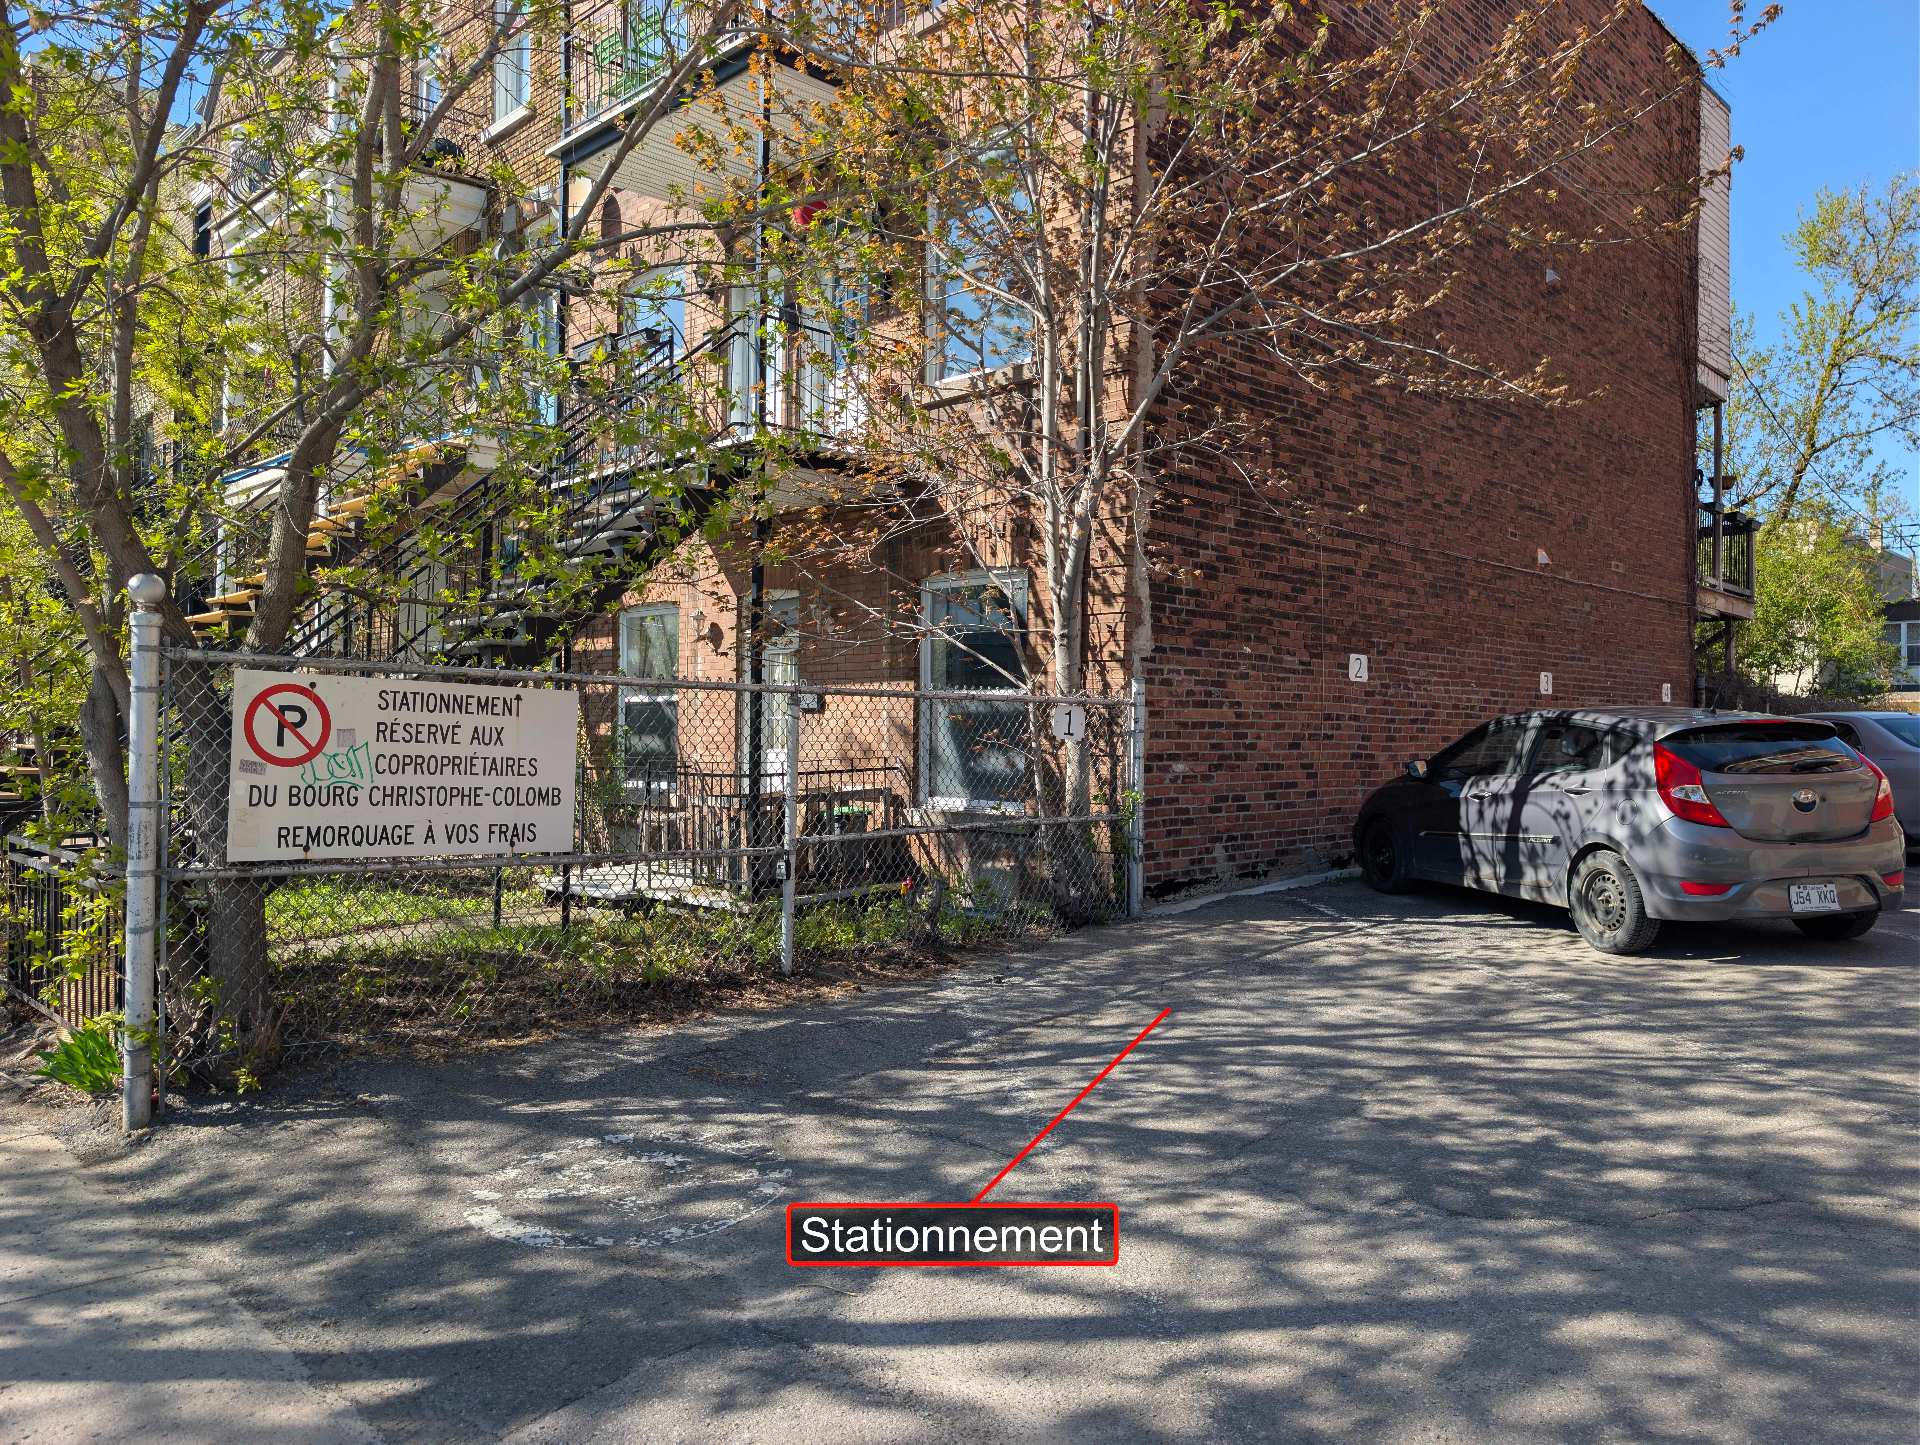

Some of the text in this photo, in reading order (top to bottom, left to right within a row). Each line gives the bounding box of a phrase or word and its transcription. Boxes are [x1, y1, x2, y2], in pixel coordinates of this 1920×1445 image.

[1355, 657, 1363, 679] 2
[1543, 674, 1549, 692] 3
[377, 689, 523, 718] STATIONNEMENT
[375, 718, 462, 745] RÉSERVÉ
[469, 725, 505, 747] AUX
[1063, 709, 1075, 737] 1
[374, 752, 538, 777] COPROPRIÉTAIRES
[248, 784, 562, 808] DU BOURG CHRISTOPHE-COLOMB
[277, 819, 537, 849] REMORQUAGE À VOS FRAIS
[1793, 889, 1837, 905] J54 XKQ
